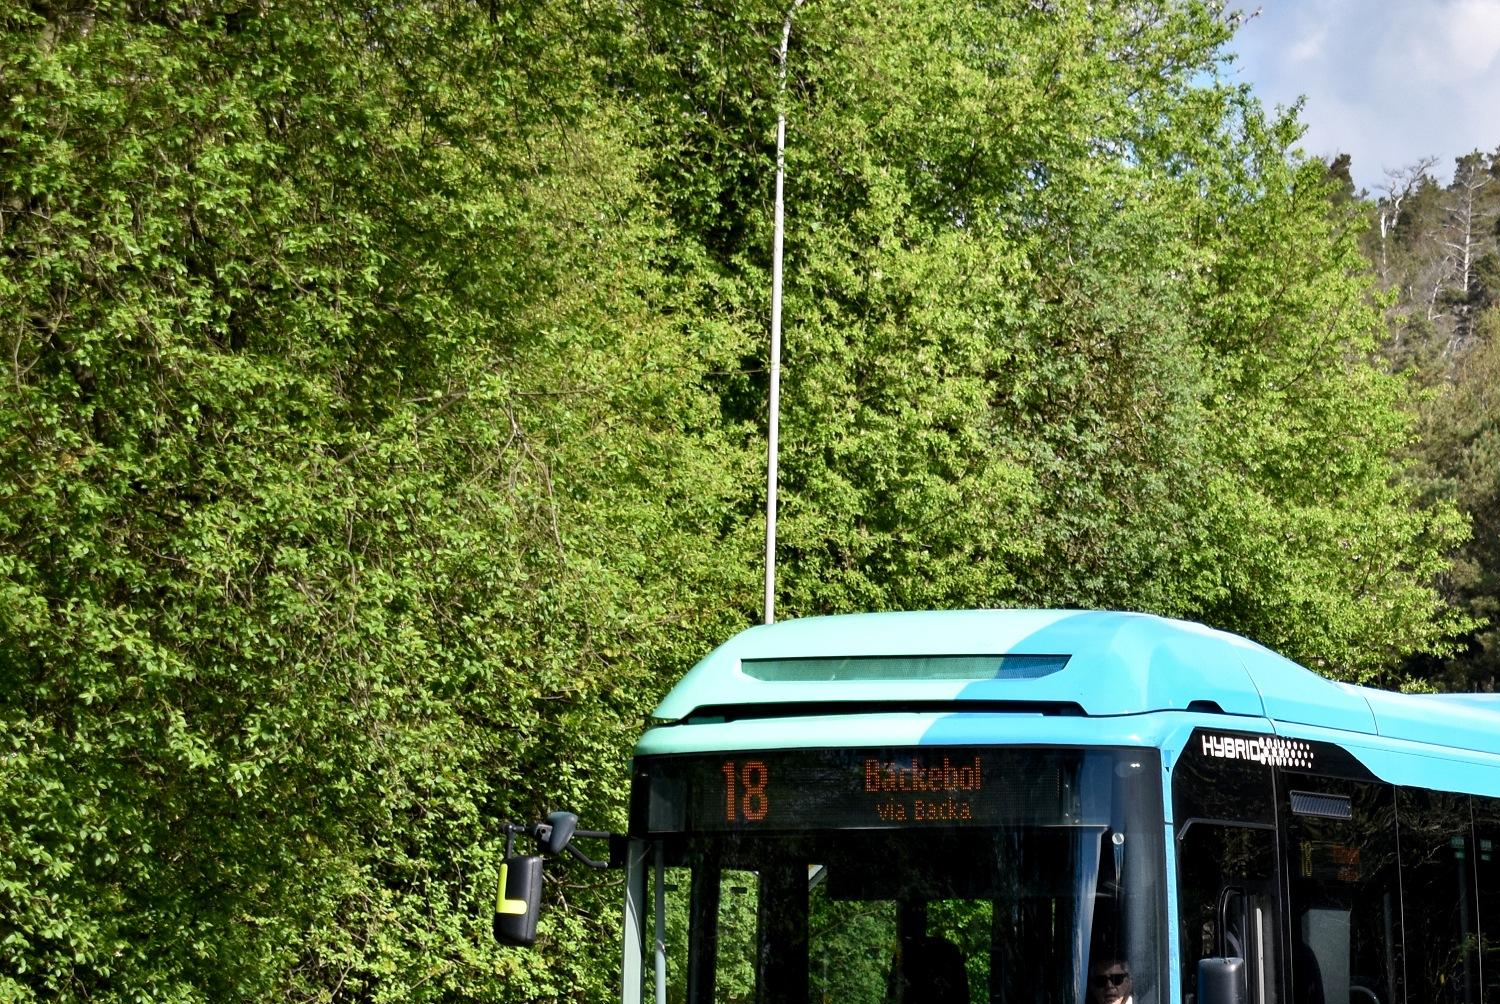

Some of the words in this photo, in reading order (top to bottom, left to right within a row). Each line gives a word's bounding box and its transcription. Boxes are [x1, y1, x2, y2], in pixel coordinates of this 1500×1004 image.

[1202, 735, 1262, 762] HYBRID
[723, 759, 768, 821] 18
[877, 797, 907, 821] via
[914, 796, 972, 820] Backa
